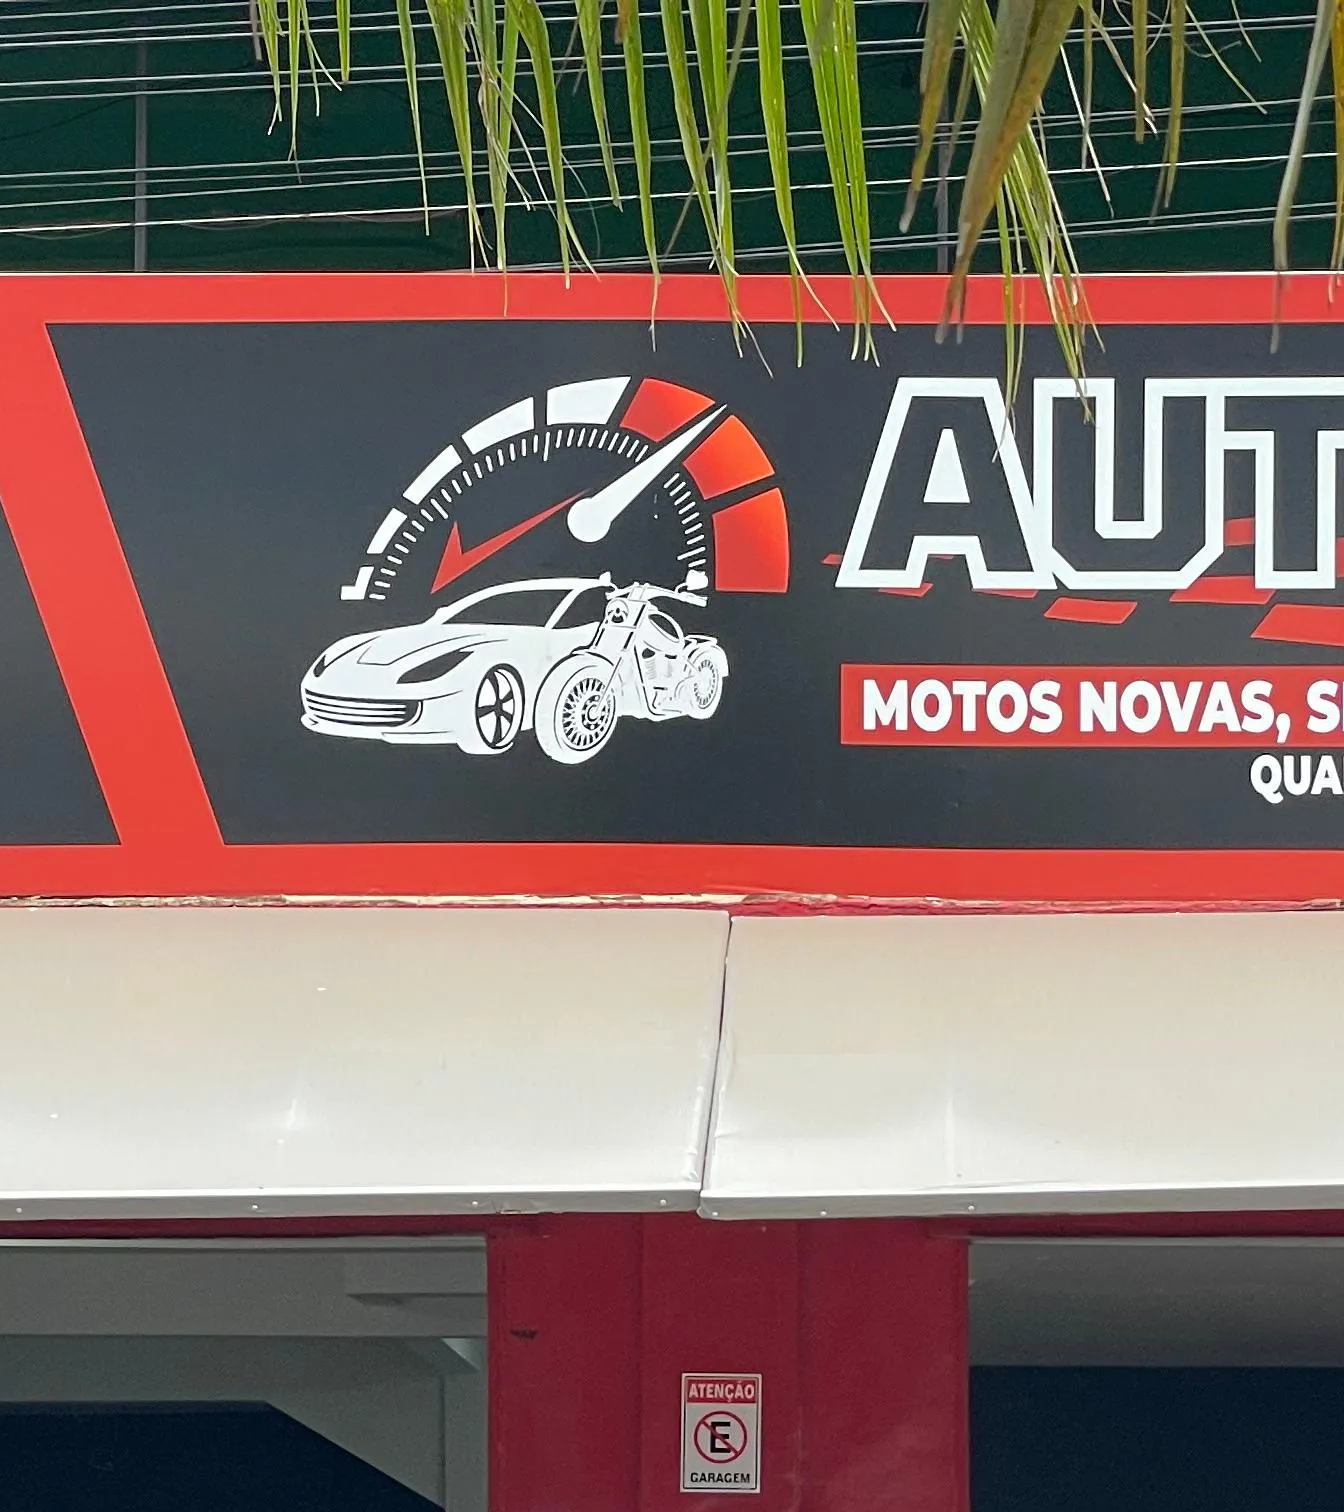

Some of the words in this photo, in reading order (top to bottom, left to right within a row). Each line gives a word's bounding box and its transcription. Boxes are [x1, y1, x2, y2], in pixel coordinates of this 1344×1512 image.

[862, 677, 1063, 735] MOTOS
[1078, 678, 1292, 745] NOVAS,
[689, 1381, 755, 1403] ATENÇÃO
[710, 1421, 732, 1453] E
[690, 1472, 751, 1484] GARAGEM
